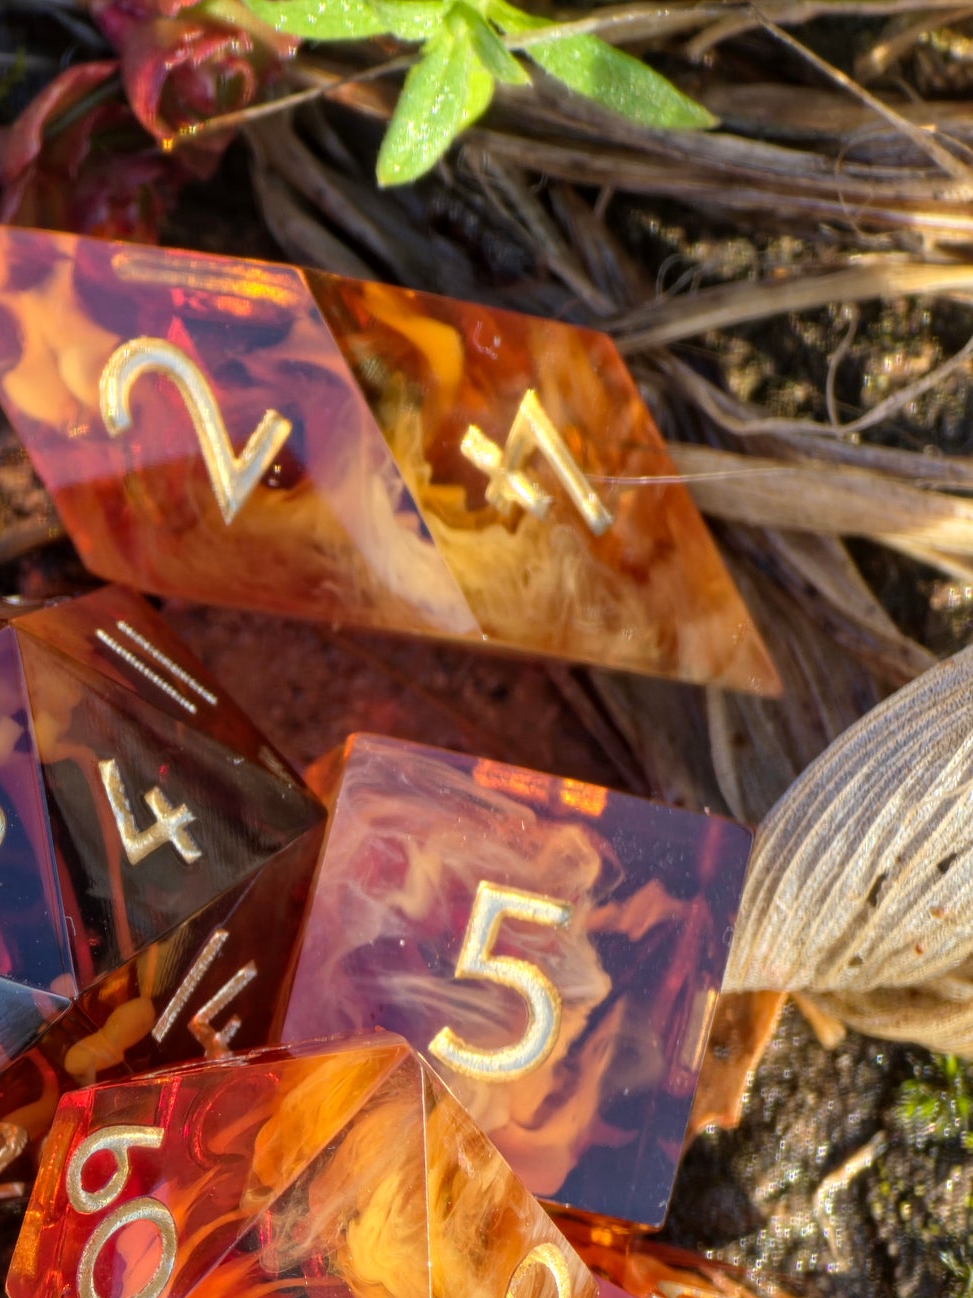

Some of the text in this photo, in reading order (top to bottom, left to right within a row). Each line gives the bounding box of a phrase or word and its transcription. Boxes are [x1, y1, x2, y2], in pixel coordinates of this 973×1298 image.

[100, 334, 293, 525] 2
[460, 388, 615, 537] 4
[97, 758, 202, 866] 4
[427, 879, 574, 1083] 5
